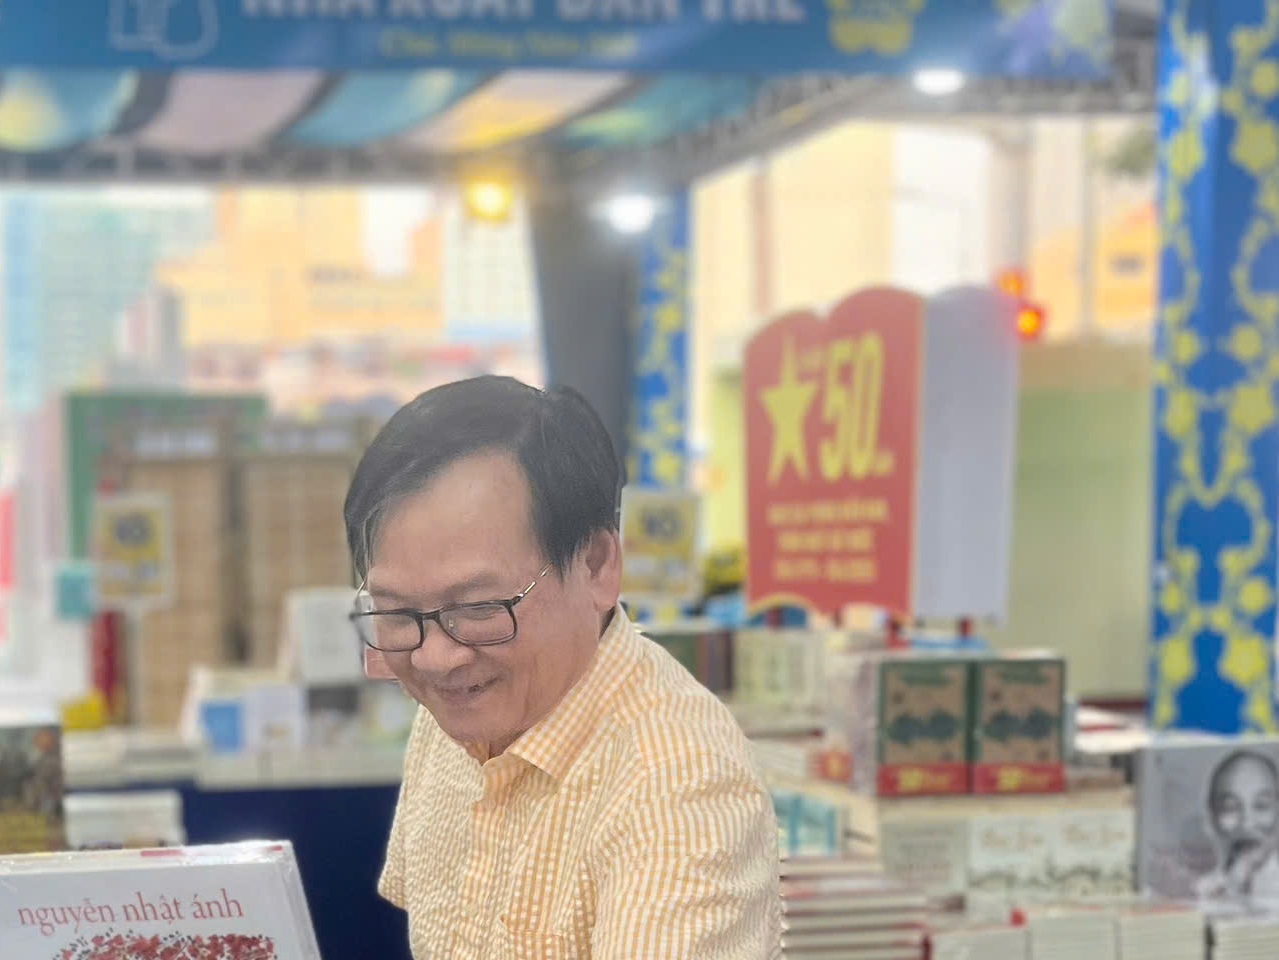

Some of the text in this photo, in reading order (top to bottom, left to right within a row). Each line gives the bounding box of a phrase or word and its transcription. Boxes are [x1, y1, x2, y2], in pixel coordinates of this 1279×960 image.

[17, 888, 245, 937] nguyễn nhật ánh
